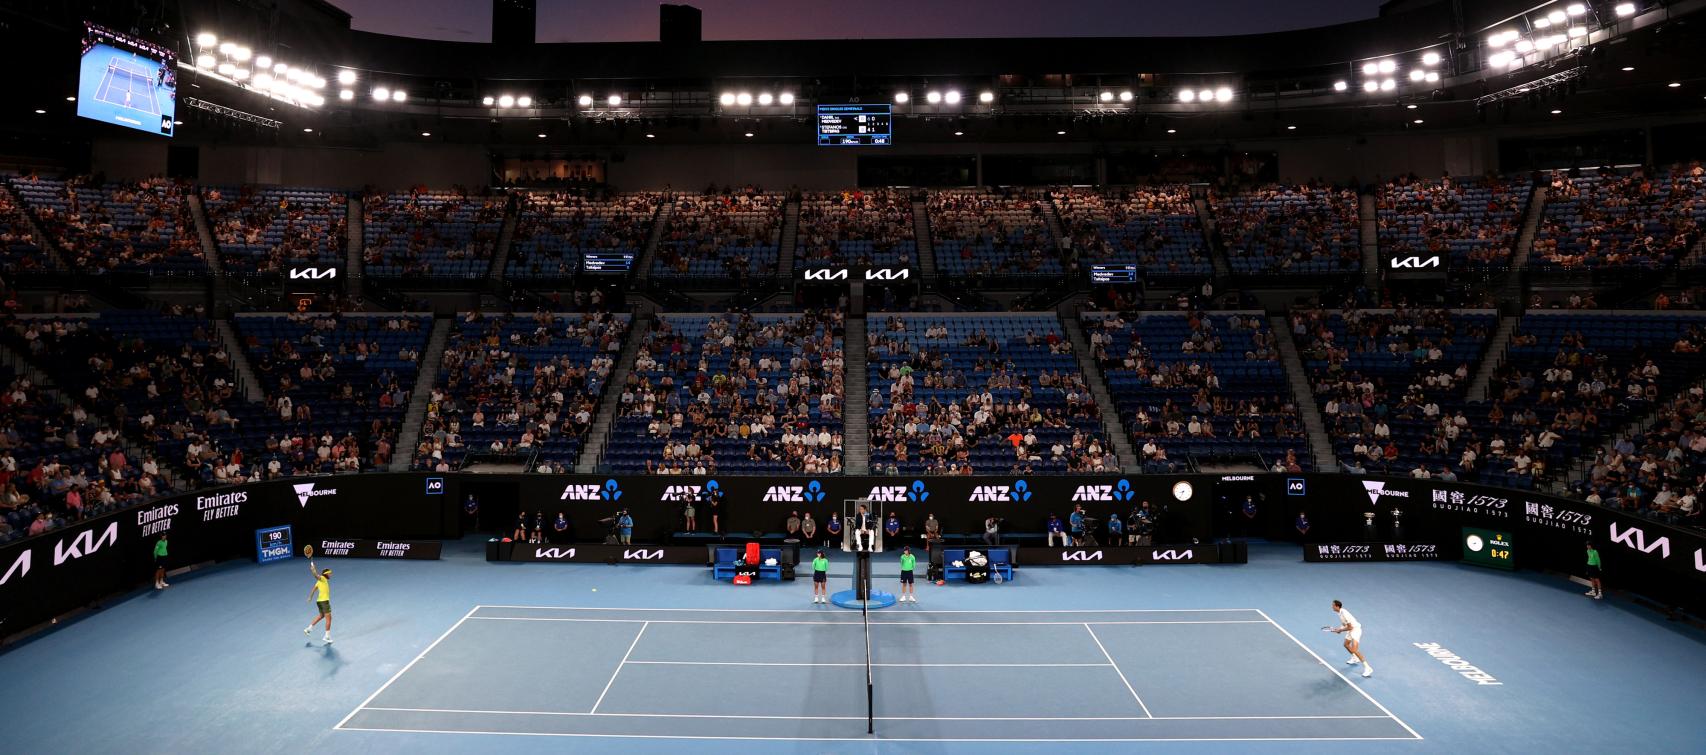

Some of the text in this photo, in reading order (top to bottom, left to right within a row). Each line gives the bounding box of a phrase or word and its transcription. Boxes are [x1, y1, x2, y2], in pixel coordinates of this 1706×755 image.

[196, 491, 248, 511] Emirates
[561, 485, 600, 501] ANZ
[763, 486, 804, 502] ANZ
[866, 486, 908, 502] ANZ
[969, 486, 1010, 502] ANZ
[1072, 485, 1112, 501] ANZ
[137, 503, 179, 525] Emirates
[203, 504, 239, 522] FLY BETTER
[1485, 509, 1508, 518] 1573
[142, 517, 172, 537] FLY BETTER
[269, 532, 282, 541] 190
[321, 540, 355, 549] Emirates
[1490, 539, 1510, 547] ROLEX
[376, 541, 410, 550] Emirates
[1491, 549, 1509, 560] 0:47
[1412, 642, 1504, 685] MELBOURNE
